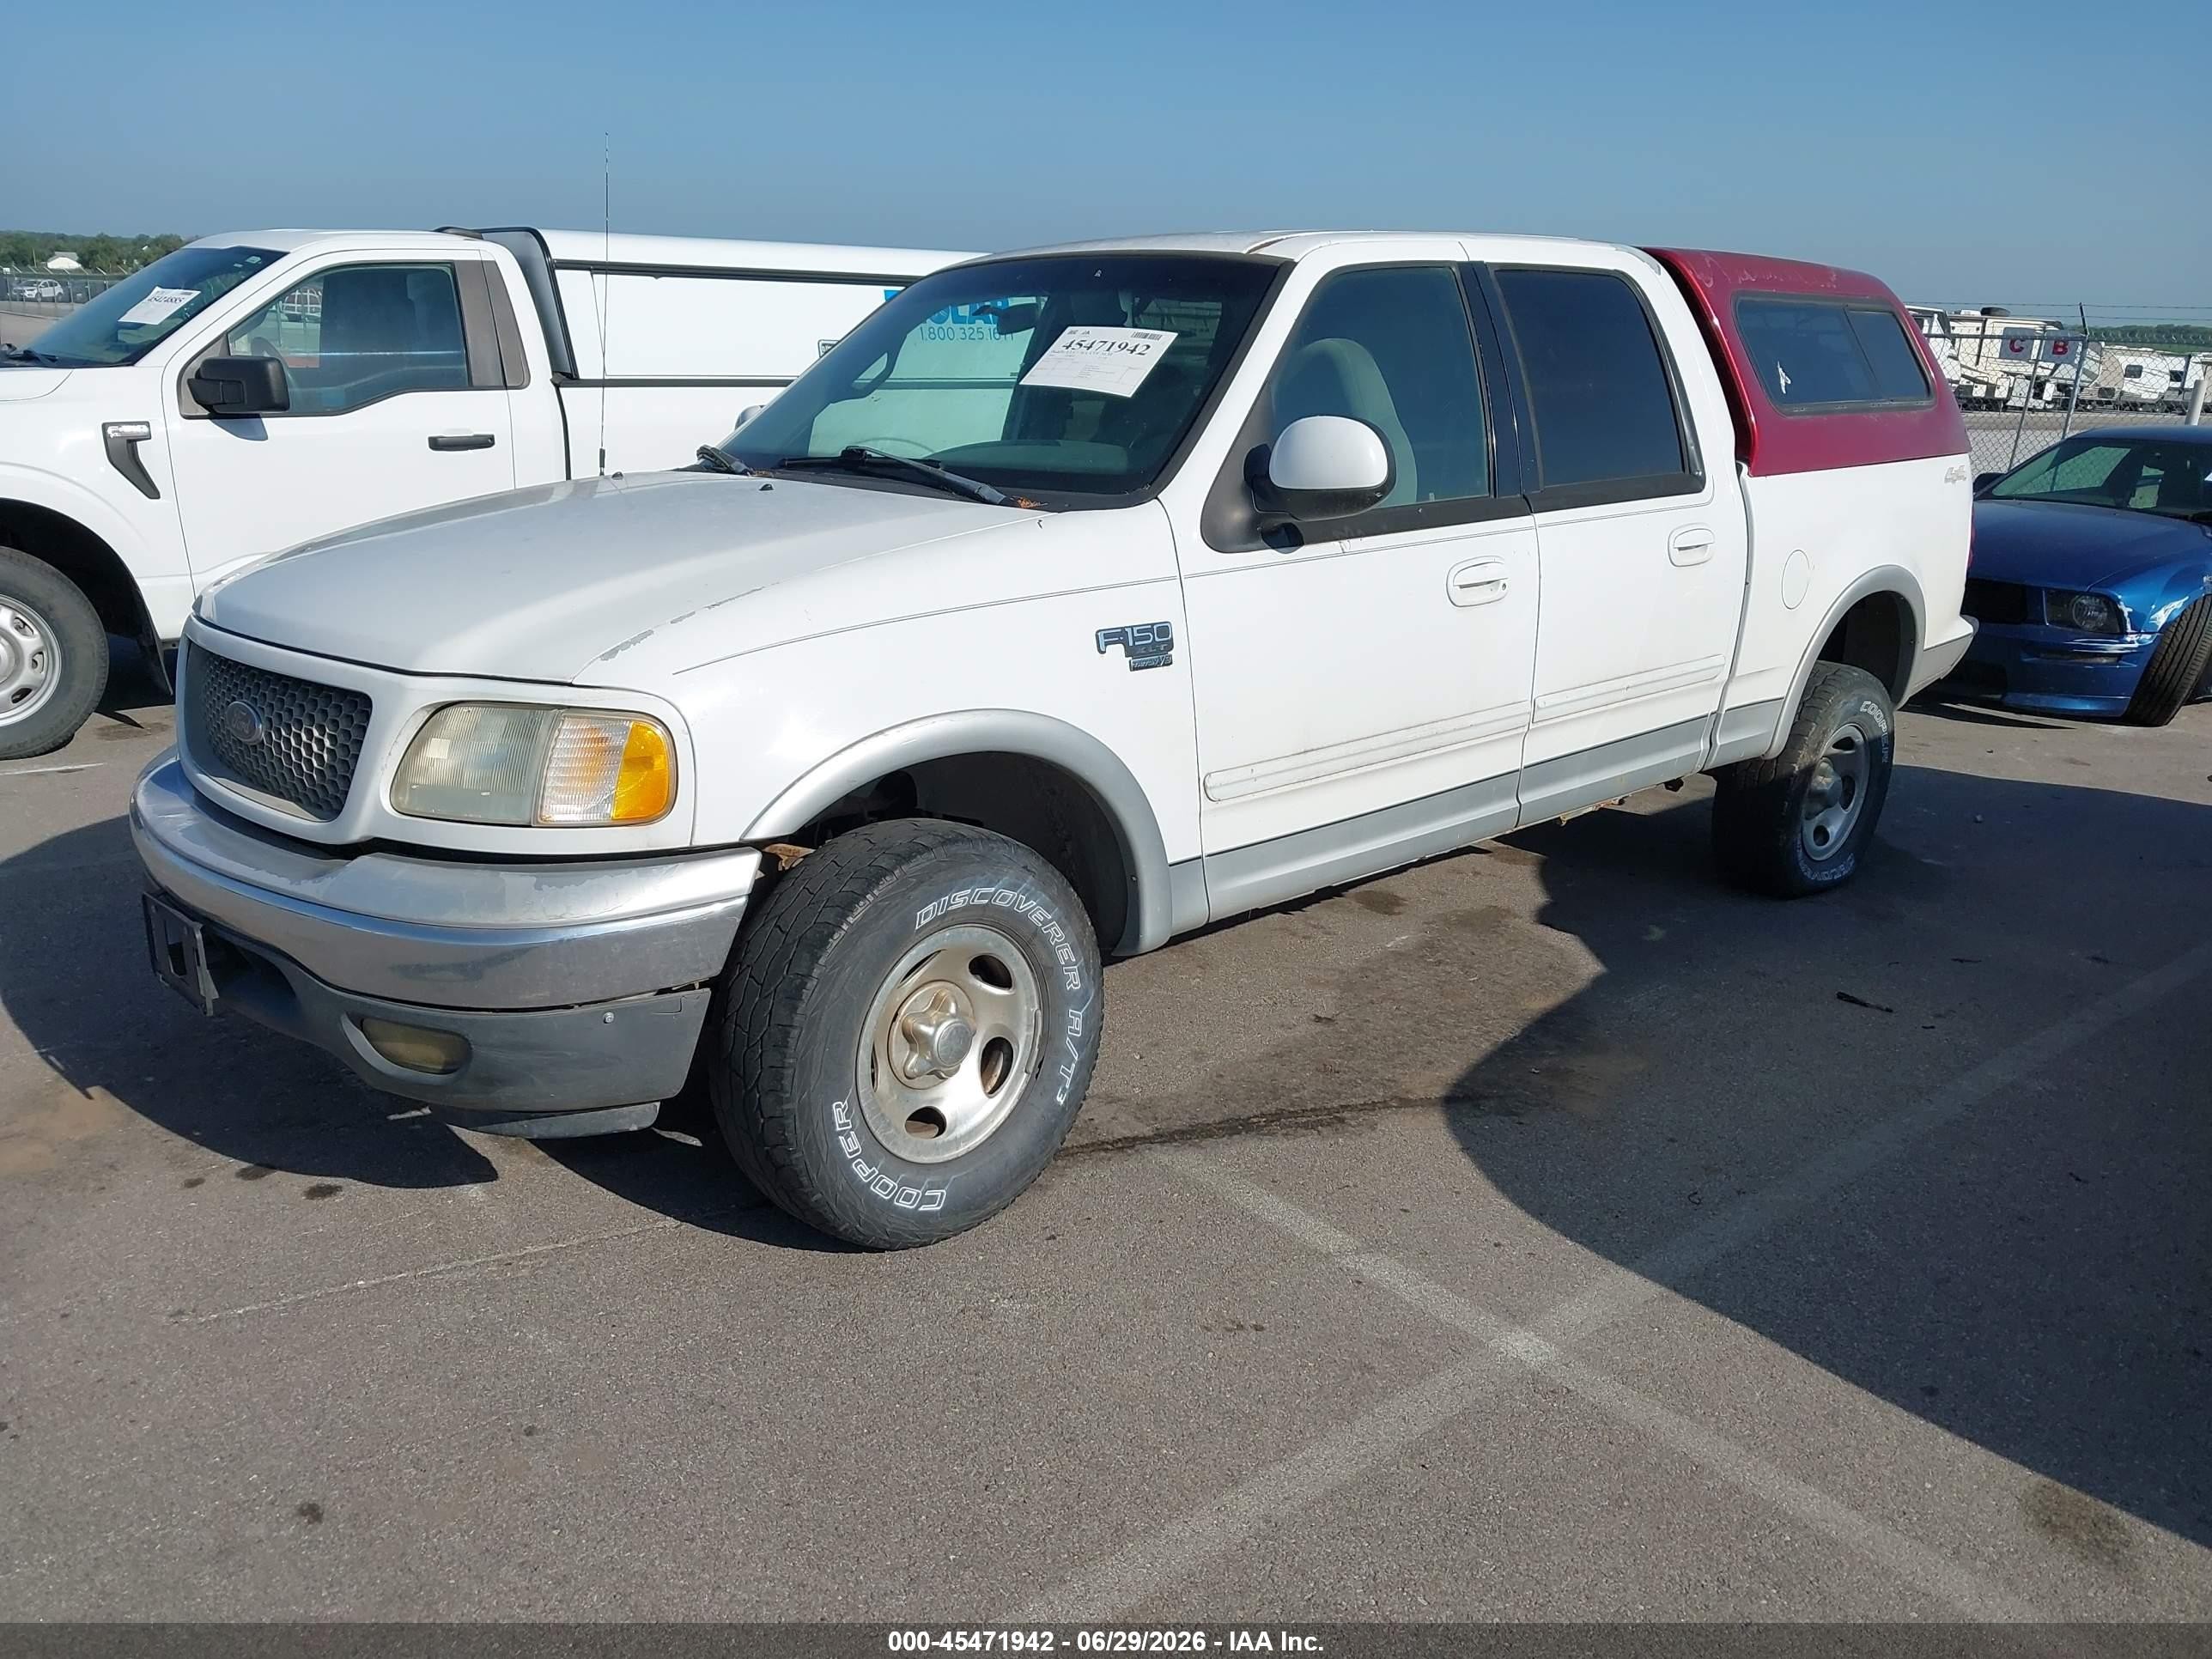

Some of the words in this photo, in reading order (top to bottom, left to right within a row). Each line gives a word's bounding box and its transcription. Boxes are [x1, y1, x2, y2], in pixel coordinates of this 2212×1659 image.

[1061, 338, 1152, 357] 45471942
[2009, 338, 2026, 353] C
[2052, 339, 2069, 356] B
[915, 886, 1083, 991] DISCOVERER
[831, 1100, 947, 1212] COOPER
